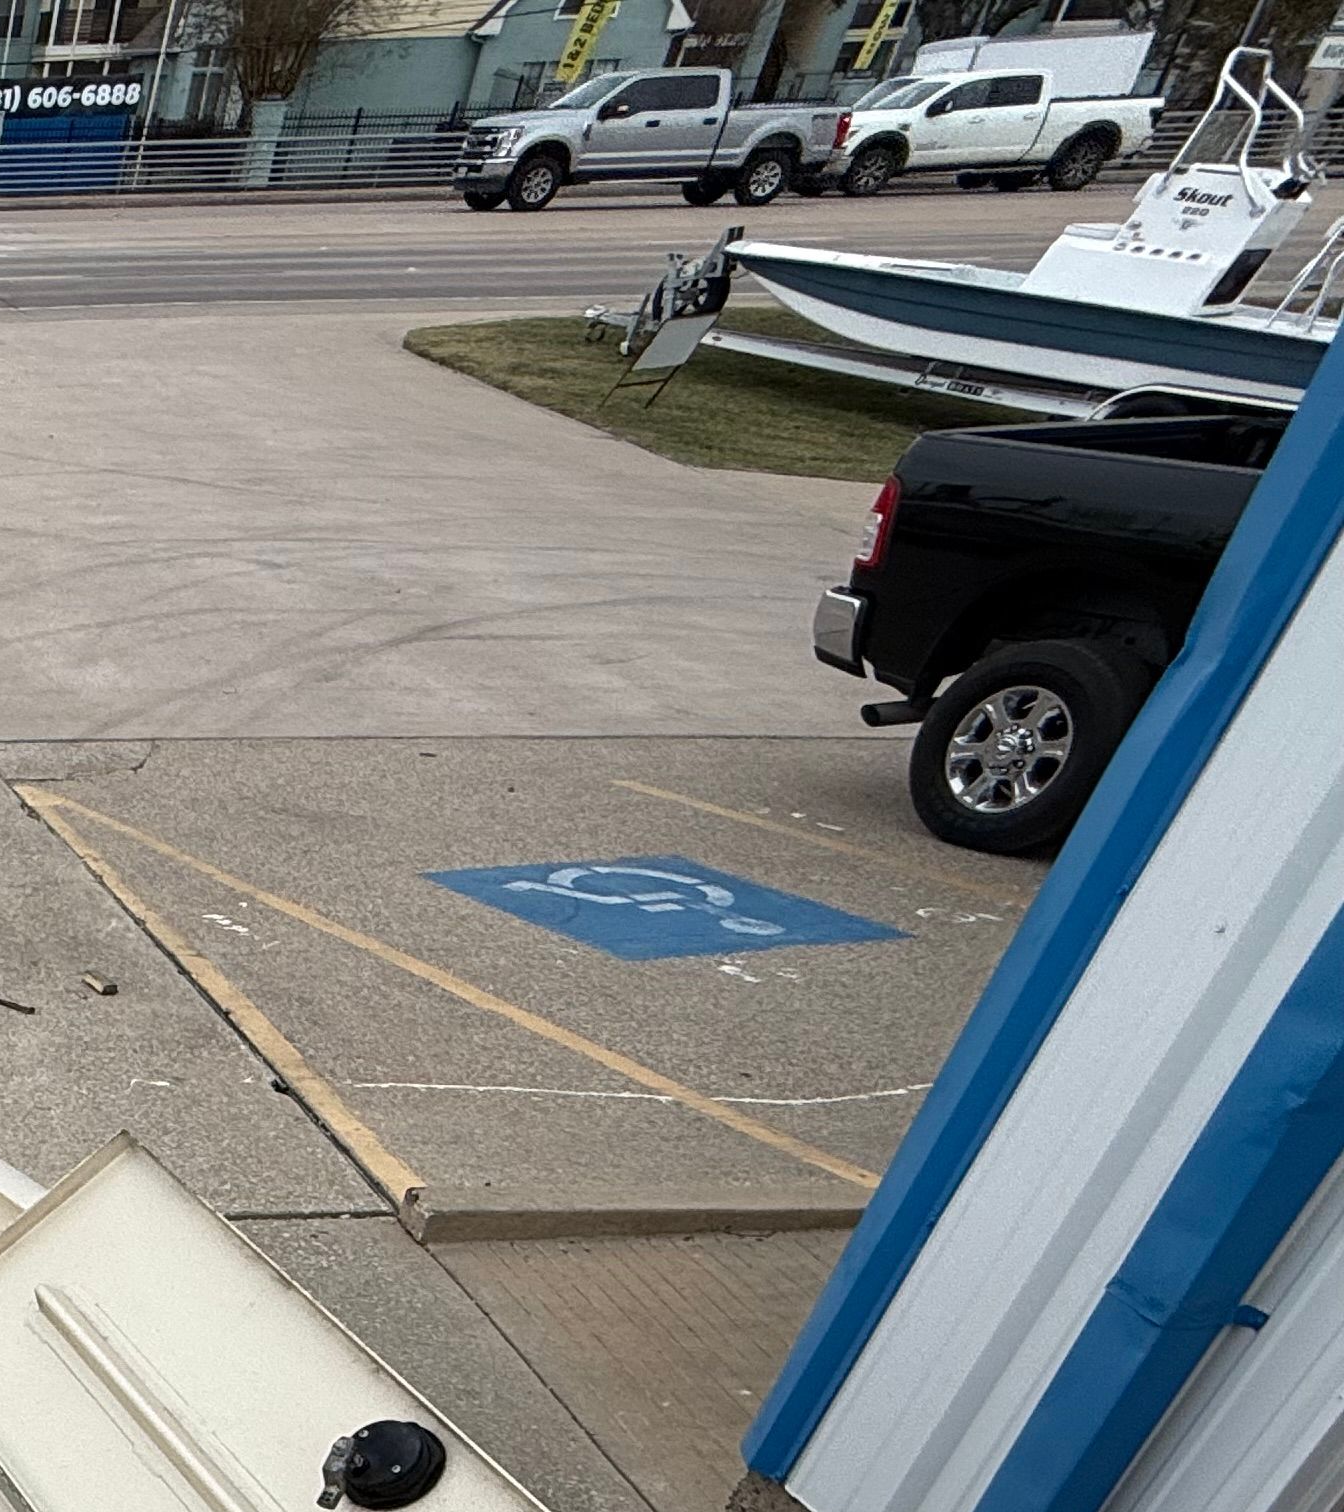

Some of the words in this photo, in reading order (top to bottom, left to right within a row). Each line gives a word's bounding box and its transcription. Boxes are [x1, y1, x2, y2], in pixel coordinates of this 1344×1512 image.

[27, 83, 141, 109] 606-6888
[1173, 186, 1233, 208] Skout
[1181, 205, 1210, 217] 220
